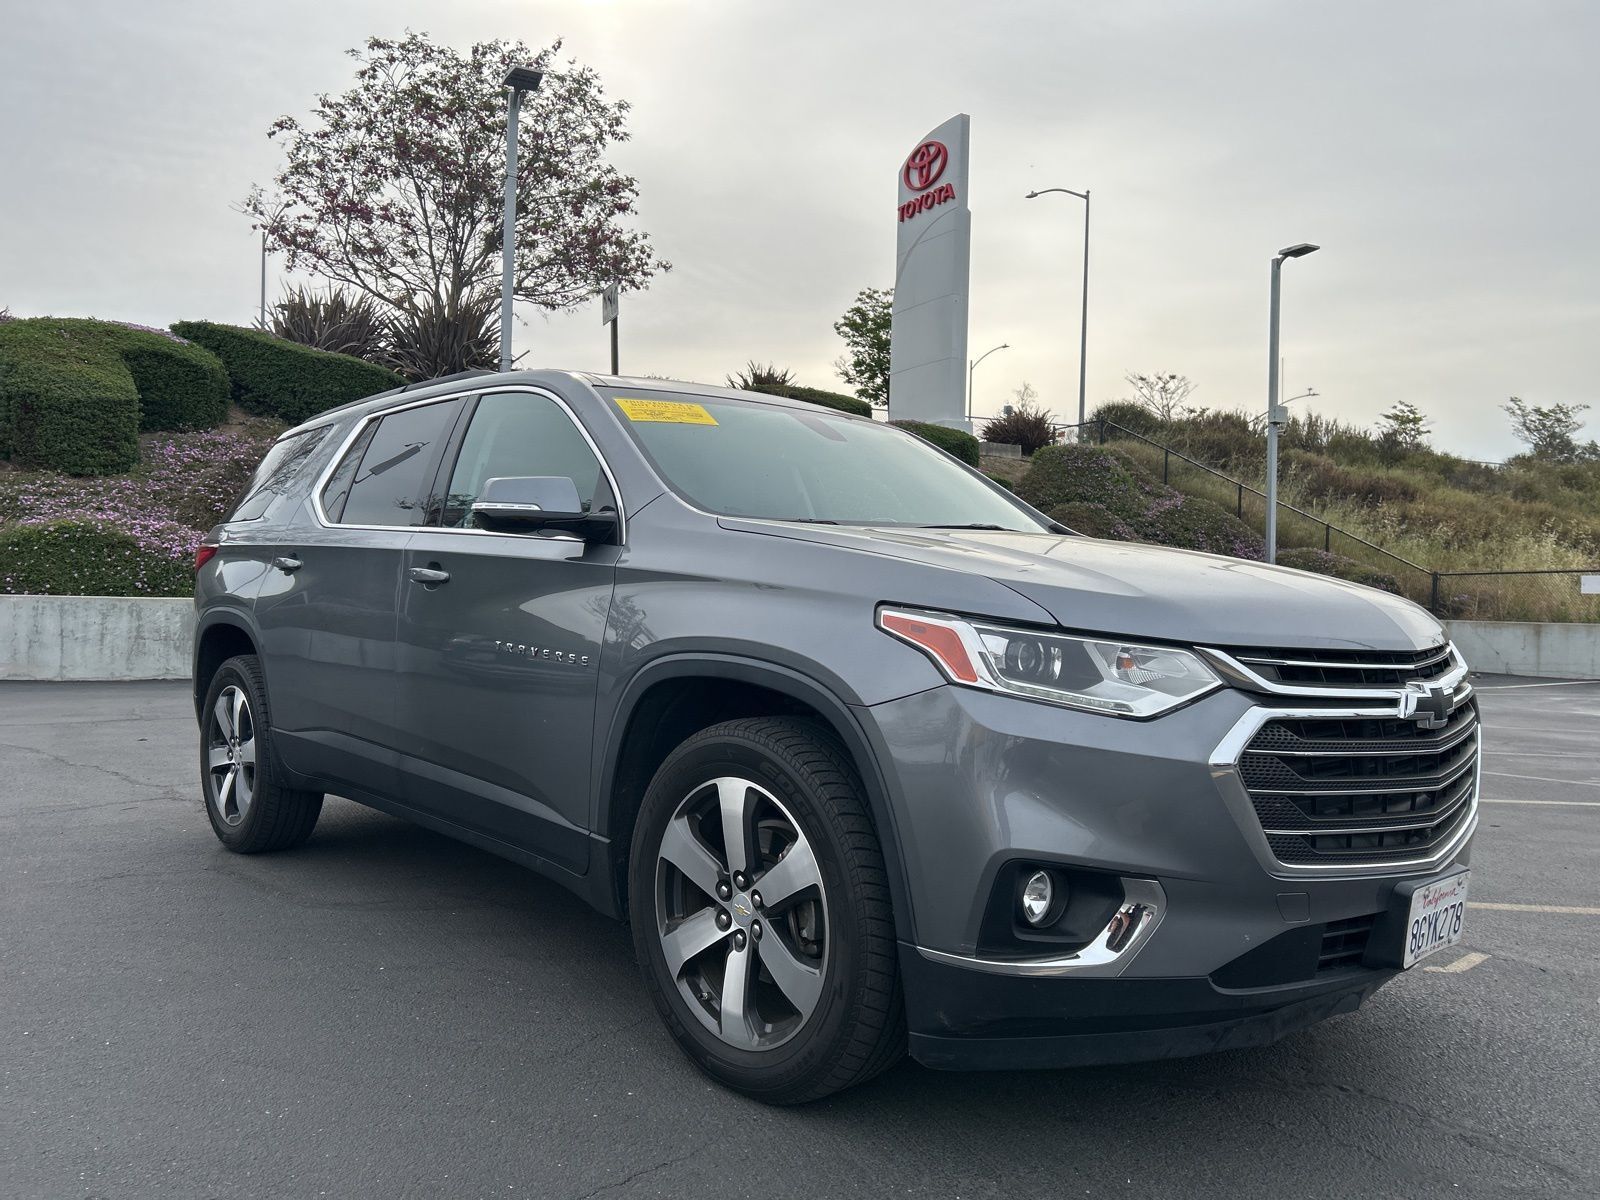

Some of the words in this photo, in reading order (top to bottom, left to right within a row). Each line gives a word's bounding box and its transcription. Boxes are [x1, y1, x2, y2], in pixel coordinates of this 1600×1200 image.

[898, 183, 956, 223] TOYOTA
[495, 640, 589, 666] TRAVERSE
[758, 760, 827, 843] EDGE
[1410, 901, 1463, 954] 8GYK278
